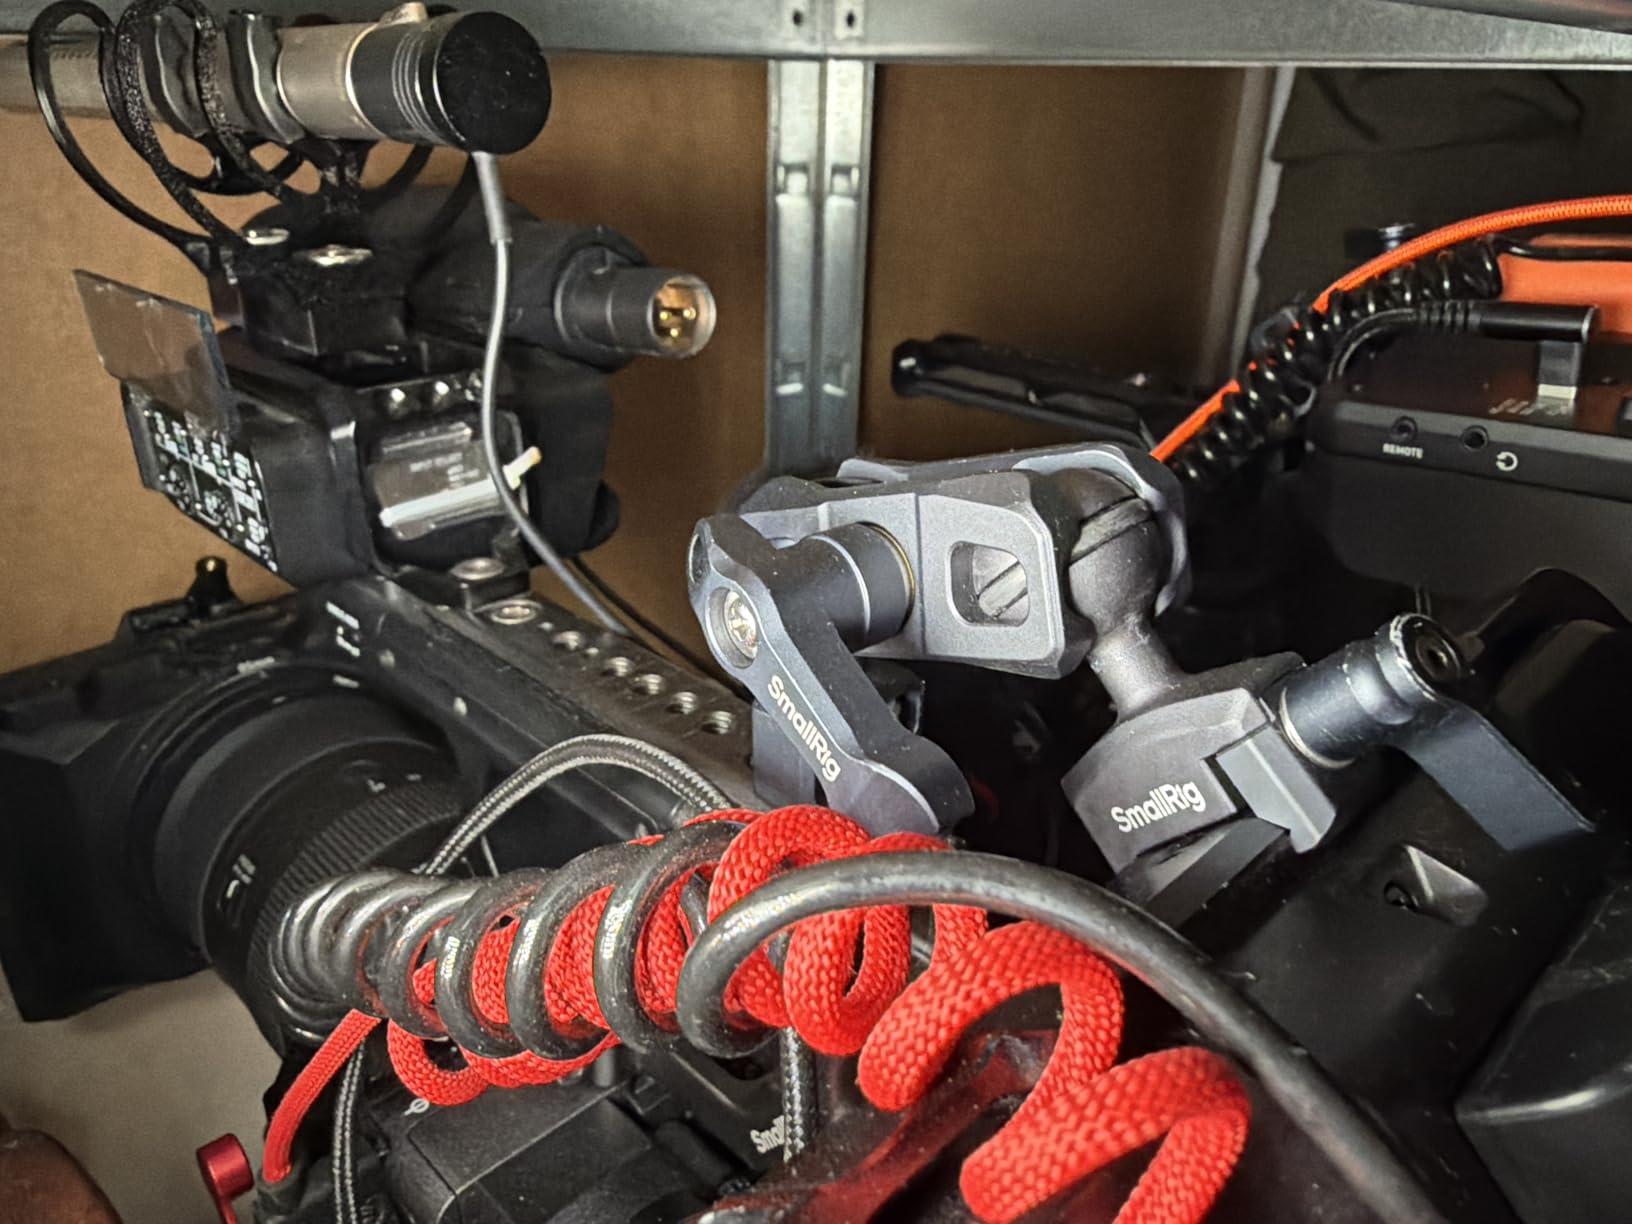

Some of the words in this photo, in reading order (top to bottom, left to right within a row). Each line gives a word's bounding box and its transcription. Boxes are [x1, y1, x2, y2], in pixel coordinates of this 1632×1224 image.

[1382, 443, 1424, 459] REMOTE
[767, 675, 841, 782] SmallRig
[1110, 781, 1206, 833] SmallRig
[750, 1114, 786, 1153] Small
